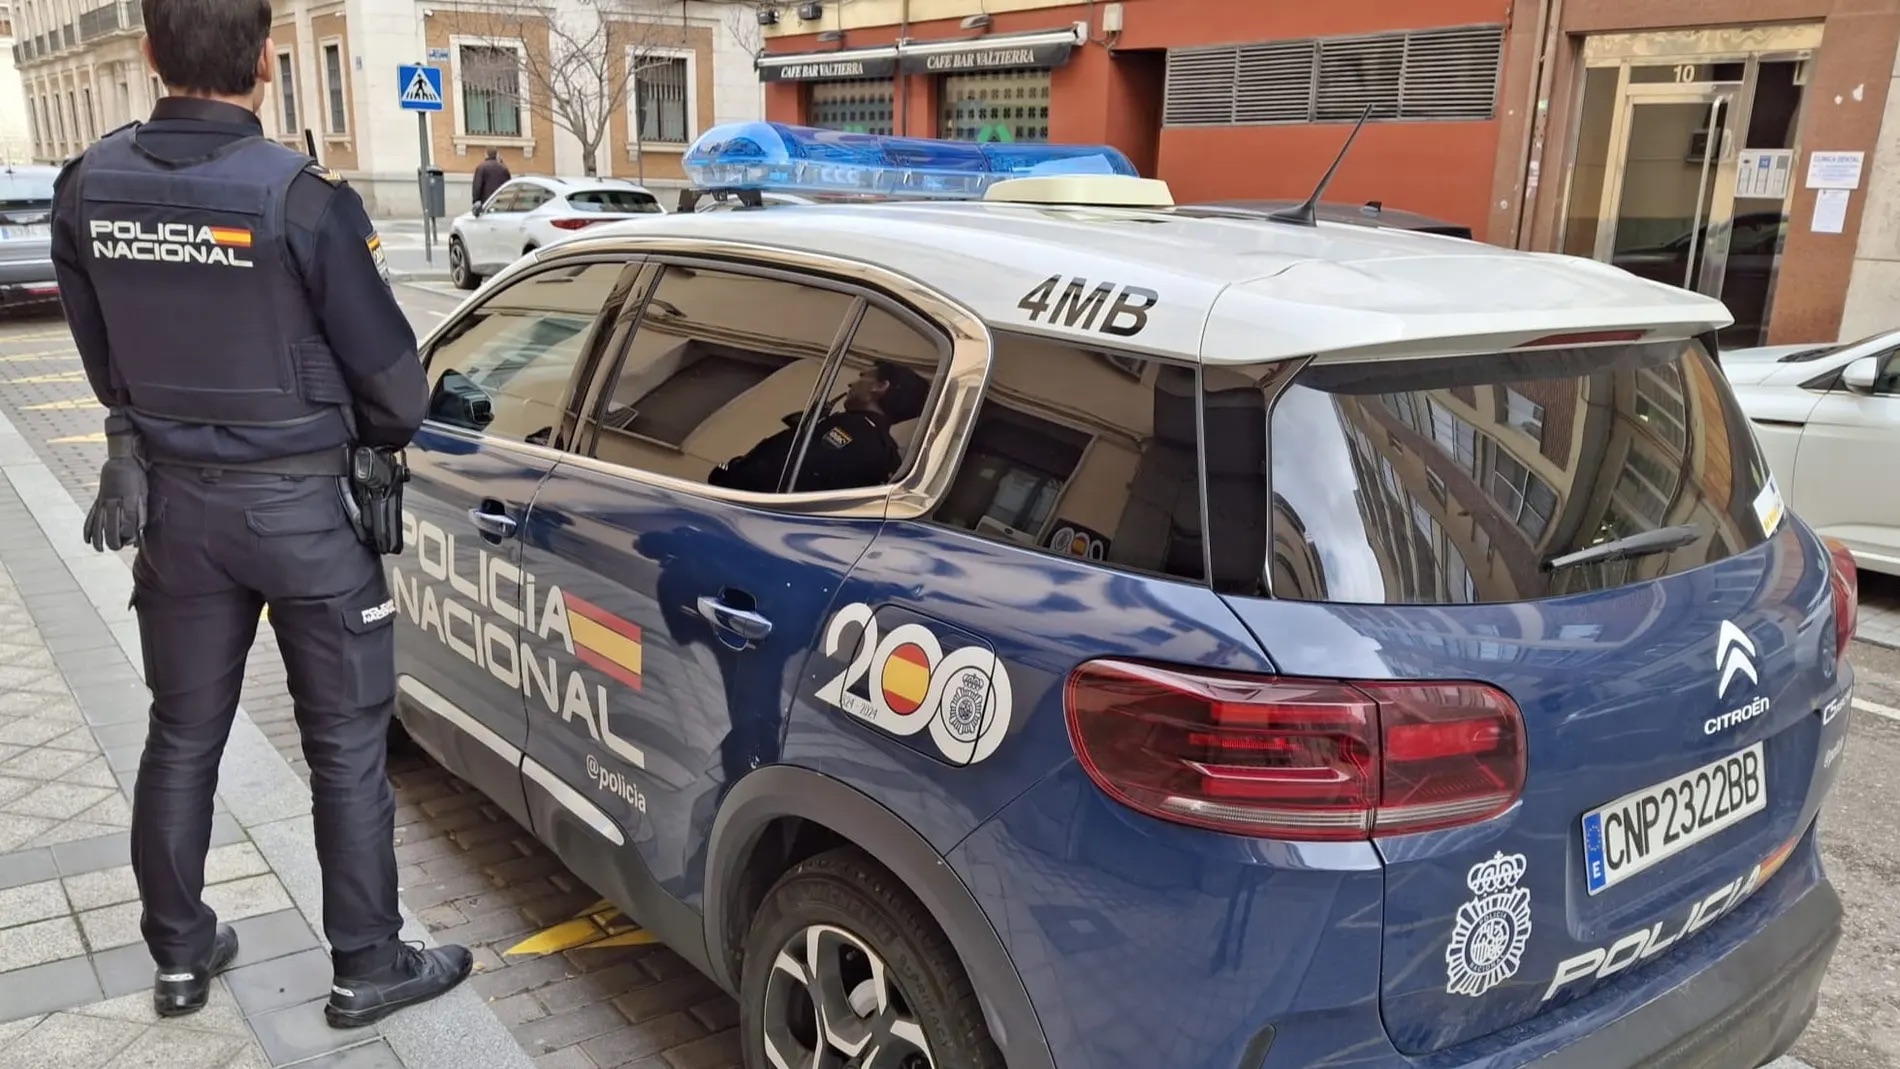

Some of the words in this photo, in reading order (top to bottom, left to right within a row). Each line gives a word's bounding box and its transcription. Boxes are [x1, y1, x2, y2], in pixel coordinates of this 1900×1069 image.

[781, 65, 802, 78] CAFE
[802, 64, 819, 77] BAR
[819, 61, 864, 77] VALTIERRA
[927, 55, 953, 69] CAFE
[953, 53, 974, 68] BAR
[976, 48, 1035, 66] VALTIERRA
[1673, 64, 1695, 83] 10
[90, 220, 217, 244] POLICIA
[93, 240, 253, 268] NACIONAL
[1017, 273, 1159, 337] 4MB
[393, 566, 645, 769] NACIONAL
[814, 602, 1013, 764] 200
[586, 754, 646, 814] @policia
[1604, 750, 1760, 871] CNP2322BB
[1592, 860, 1602, 879] E
[1542, 864, 1761, 1001] POLICIA
